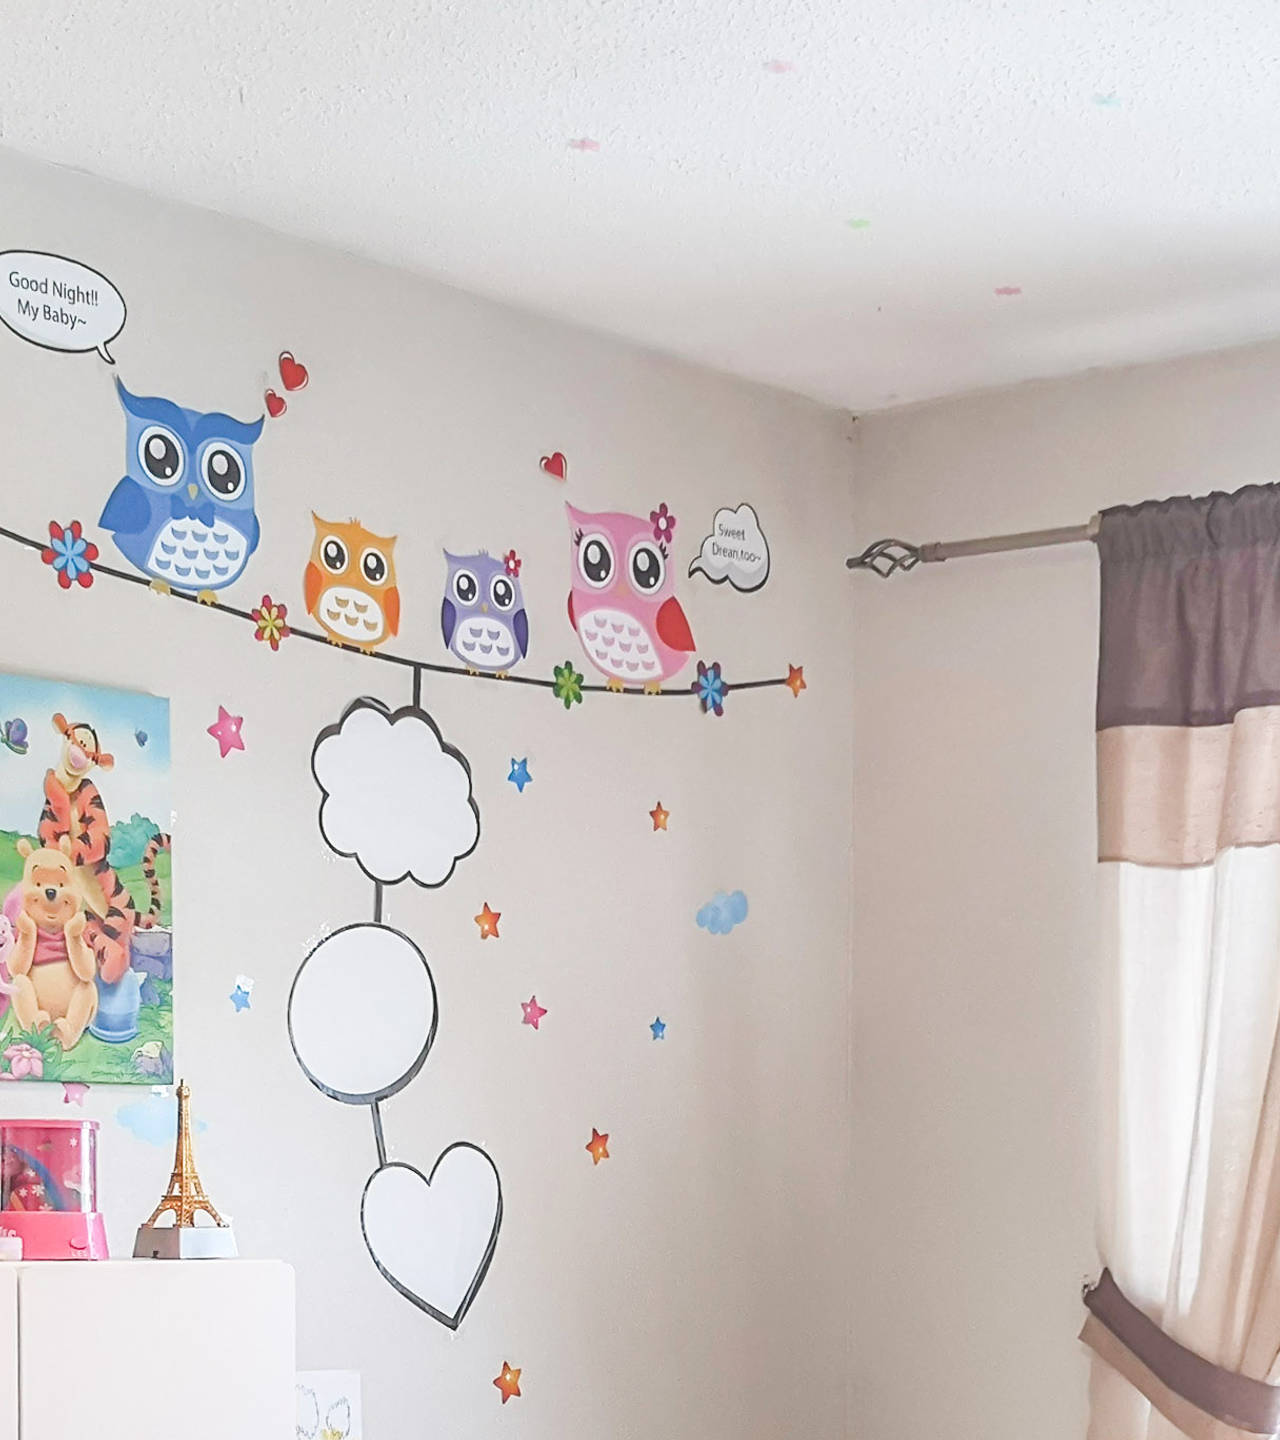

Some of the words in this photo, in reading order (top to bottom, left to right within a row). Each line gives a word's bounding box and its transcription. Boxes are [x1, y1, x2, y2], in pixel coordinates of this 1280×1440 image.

[9, 271, 48, 294] Good
[52, 280, 99, 306] Night!!
[17, 298, 39, 321] My
[718, 523, 745, 541] Sweet
